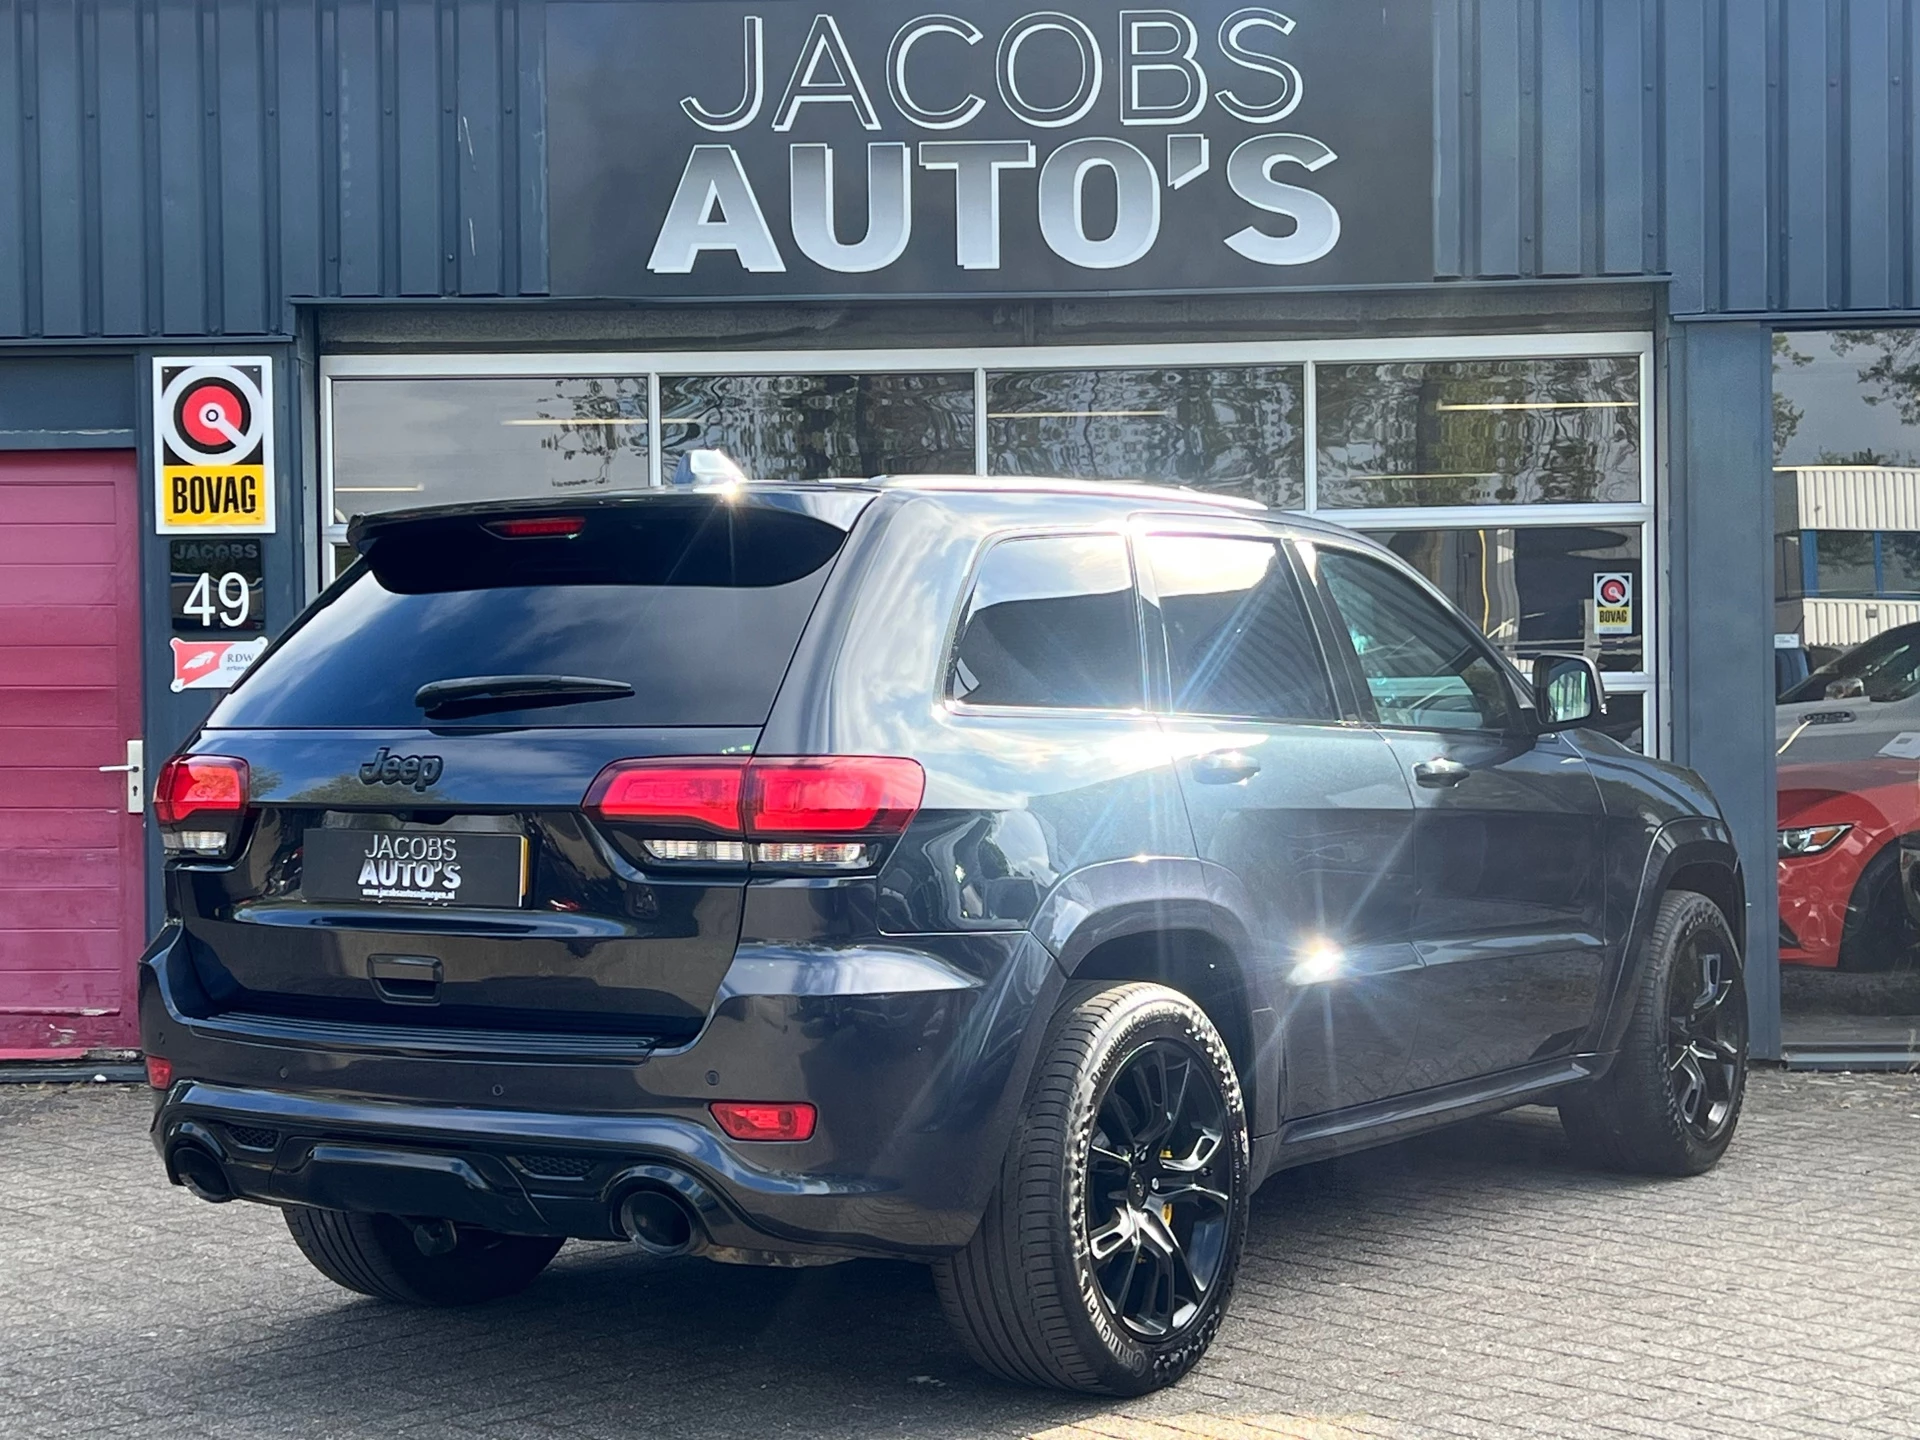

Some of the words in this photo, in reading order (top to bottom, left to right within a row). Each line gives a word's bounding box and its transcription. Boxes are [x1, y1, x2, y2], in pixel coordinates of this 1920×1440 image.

[680, 8, 1303, 132] JACOBS
[647, 134, 1341, 273] AUTO'S
[172, 475, 256, 514] BOVAG
[173, 544, 258, 560] JACOBS
[183, 572, 250, 627] 49
[1599, 610, 1627, 623] BOVAG
[227, 653, 255, 663] RDW
[359, 747, 444, 792] Jeep
[364, 834, 457, 861] JACOBS
[357, 859, 461, 889] AUTO'S
